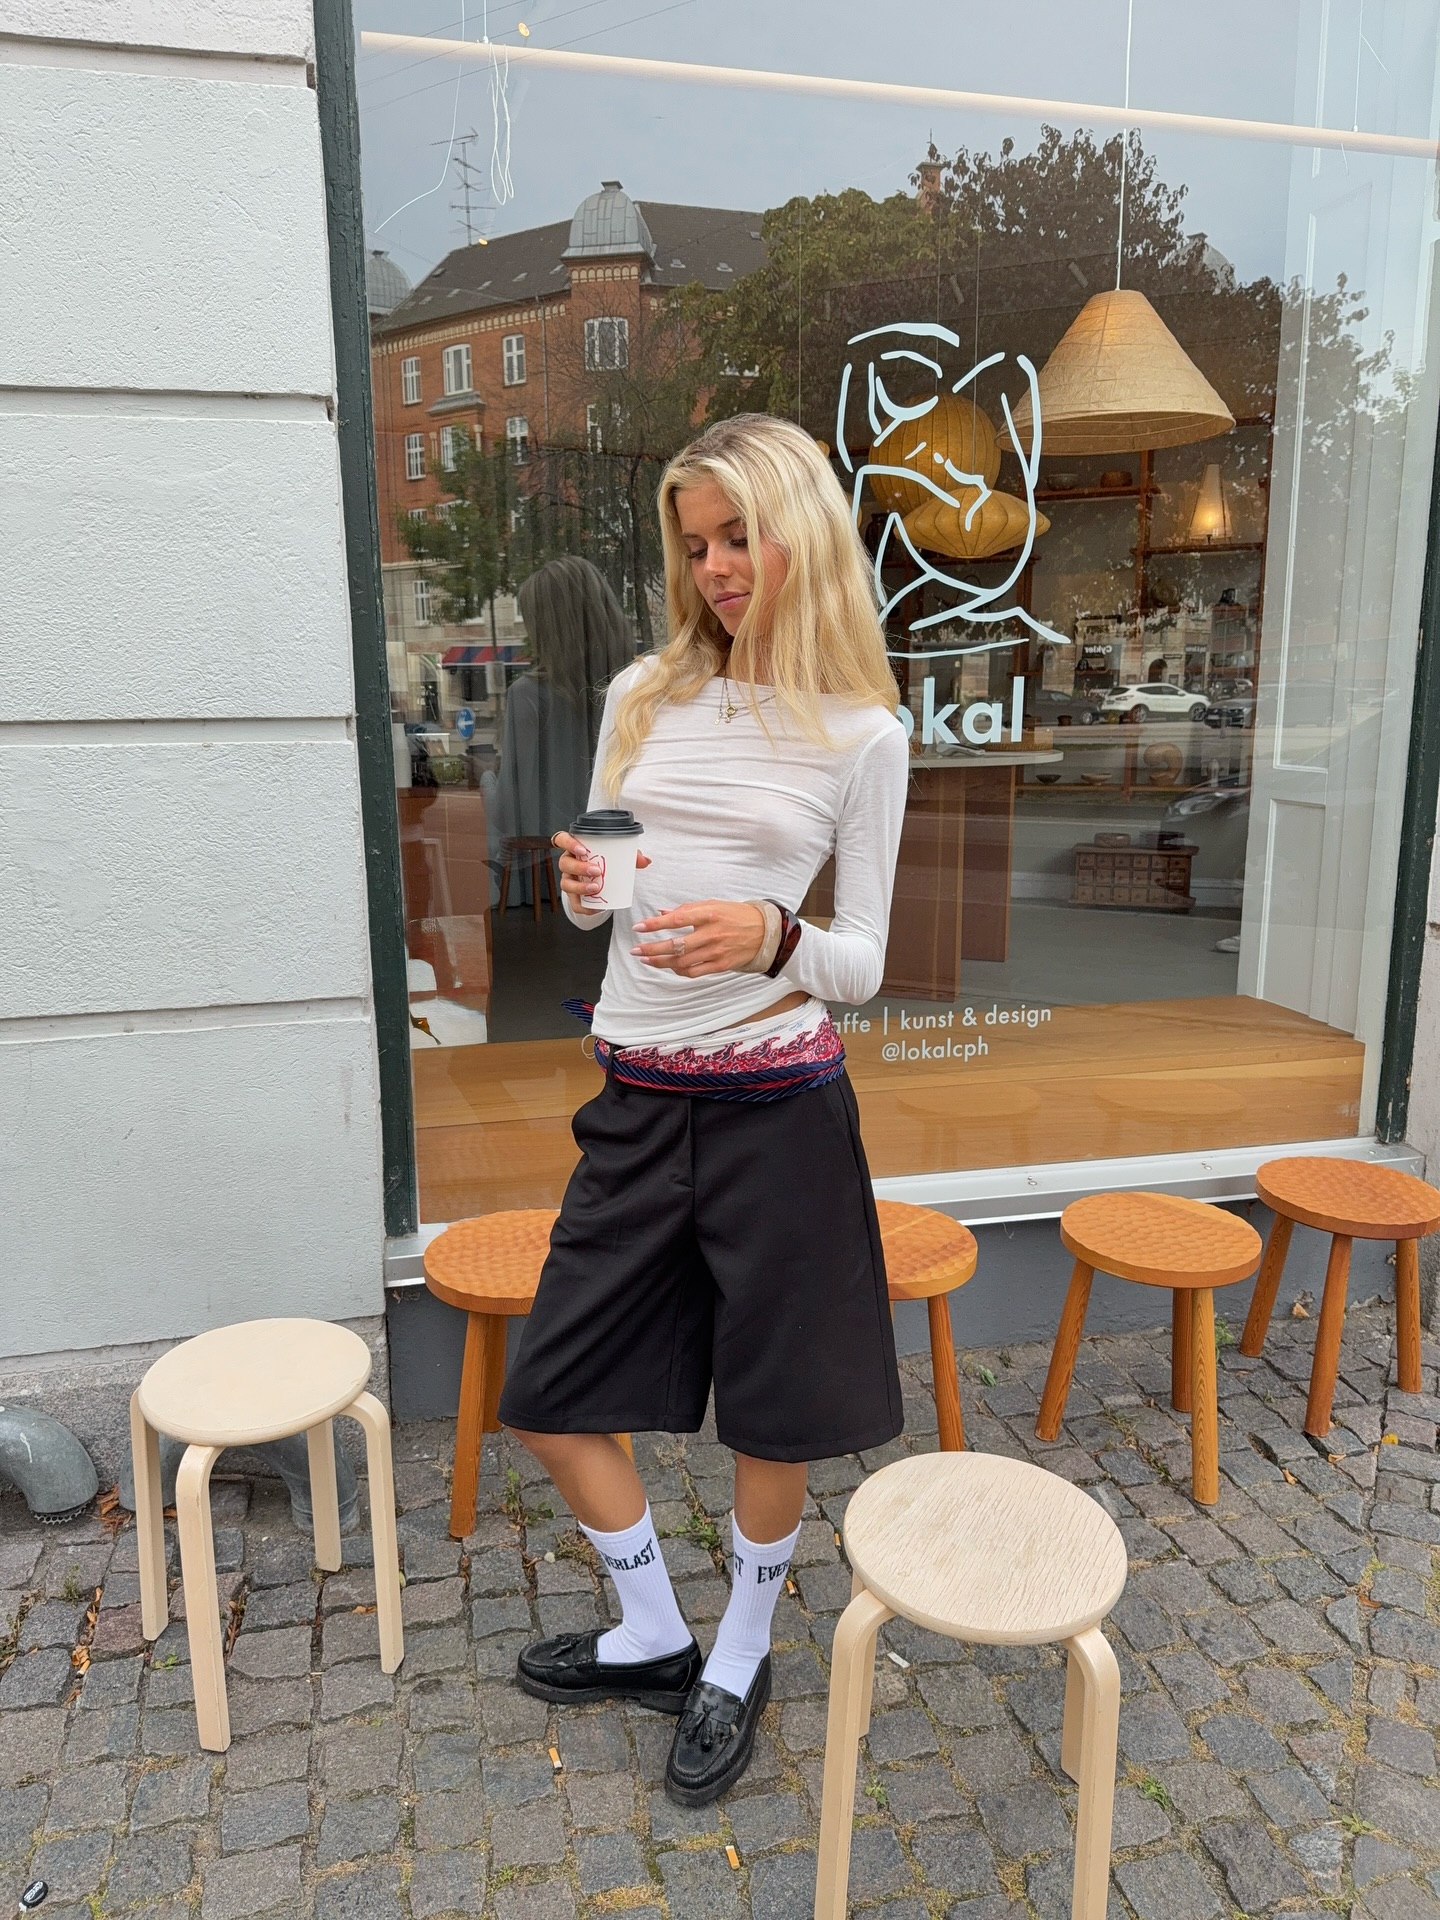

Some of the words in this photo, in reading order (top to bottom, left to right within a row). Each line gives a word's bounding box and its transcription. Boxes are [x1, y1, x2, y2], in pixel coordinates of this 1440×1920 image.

[901, 1009, 955, 1030] kunst
[962, 1006, 978, 1027] &
[984, 1004, 1052, 1028] design
[881, 1035, 989, 1062] @lokalcph
